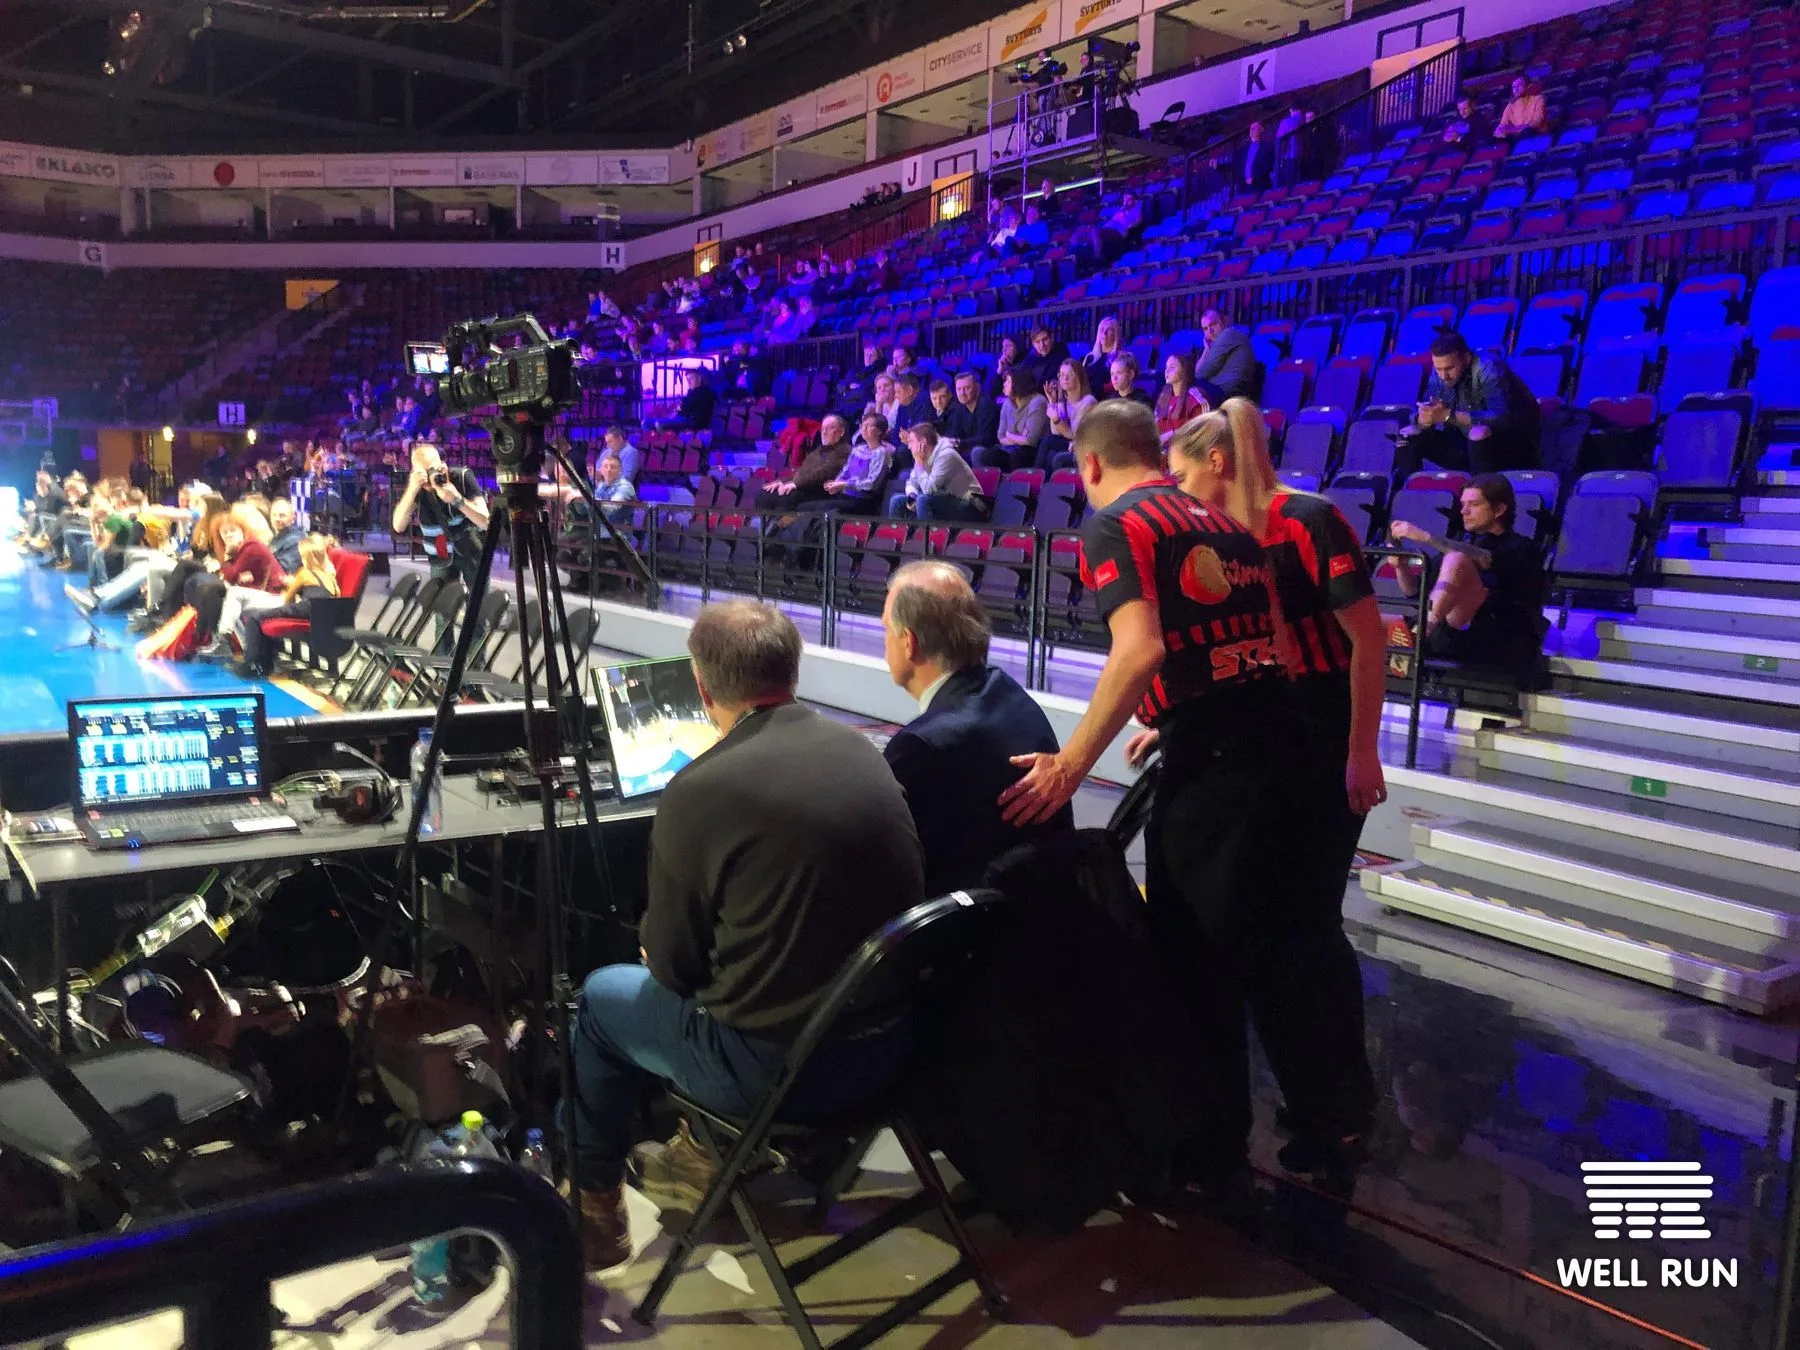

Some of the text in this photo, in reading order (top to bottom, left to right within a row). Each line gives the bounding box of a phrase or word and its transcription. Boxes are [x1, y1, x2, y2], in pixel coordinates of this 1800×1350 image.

[1246, 59, 1269, 96] K
[907, 161, 918, 187] J
[85, 246, 101, 262] G
[606, 247, 620, 264] H
[226, 405, 238, 422] H
[1755, 658, 1765, 668] 2
[1644, 782, 1651, 792] 1
